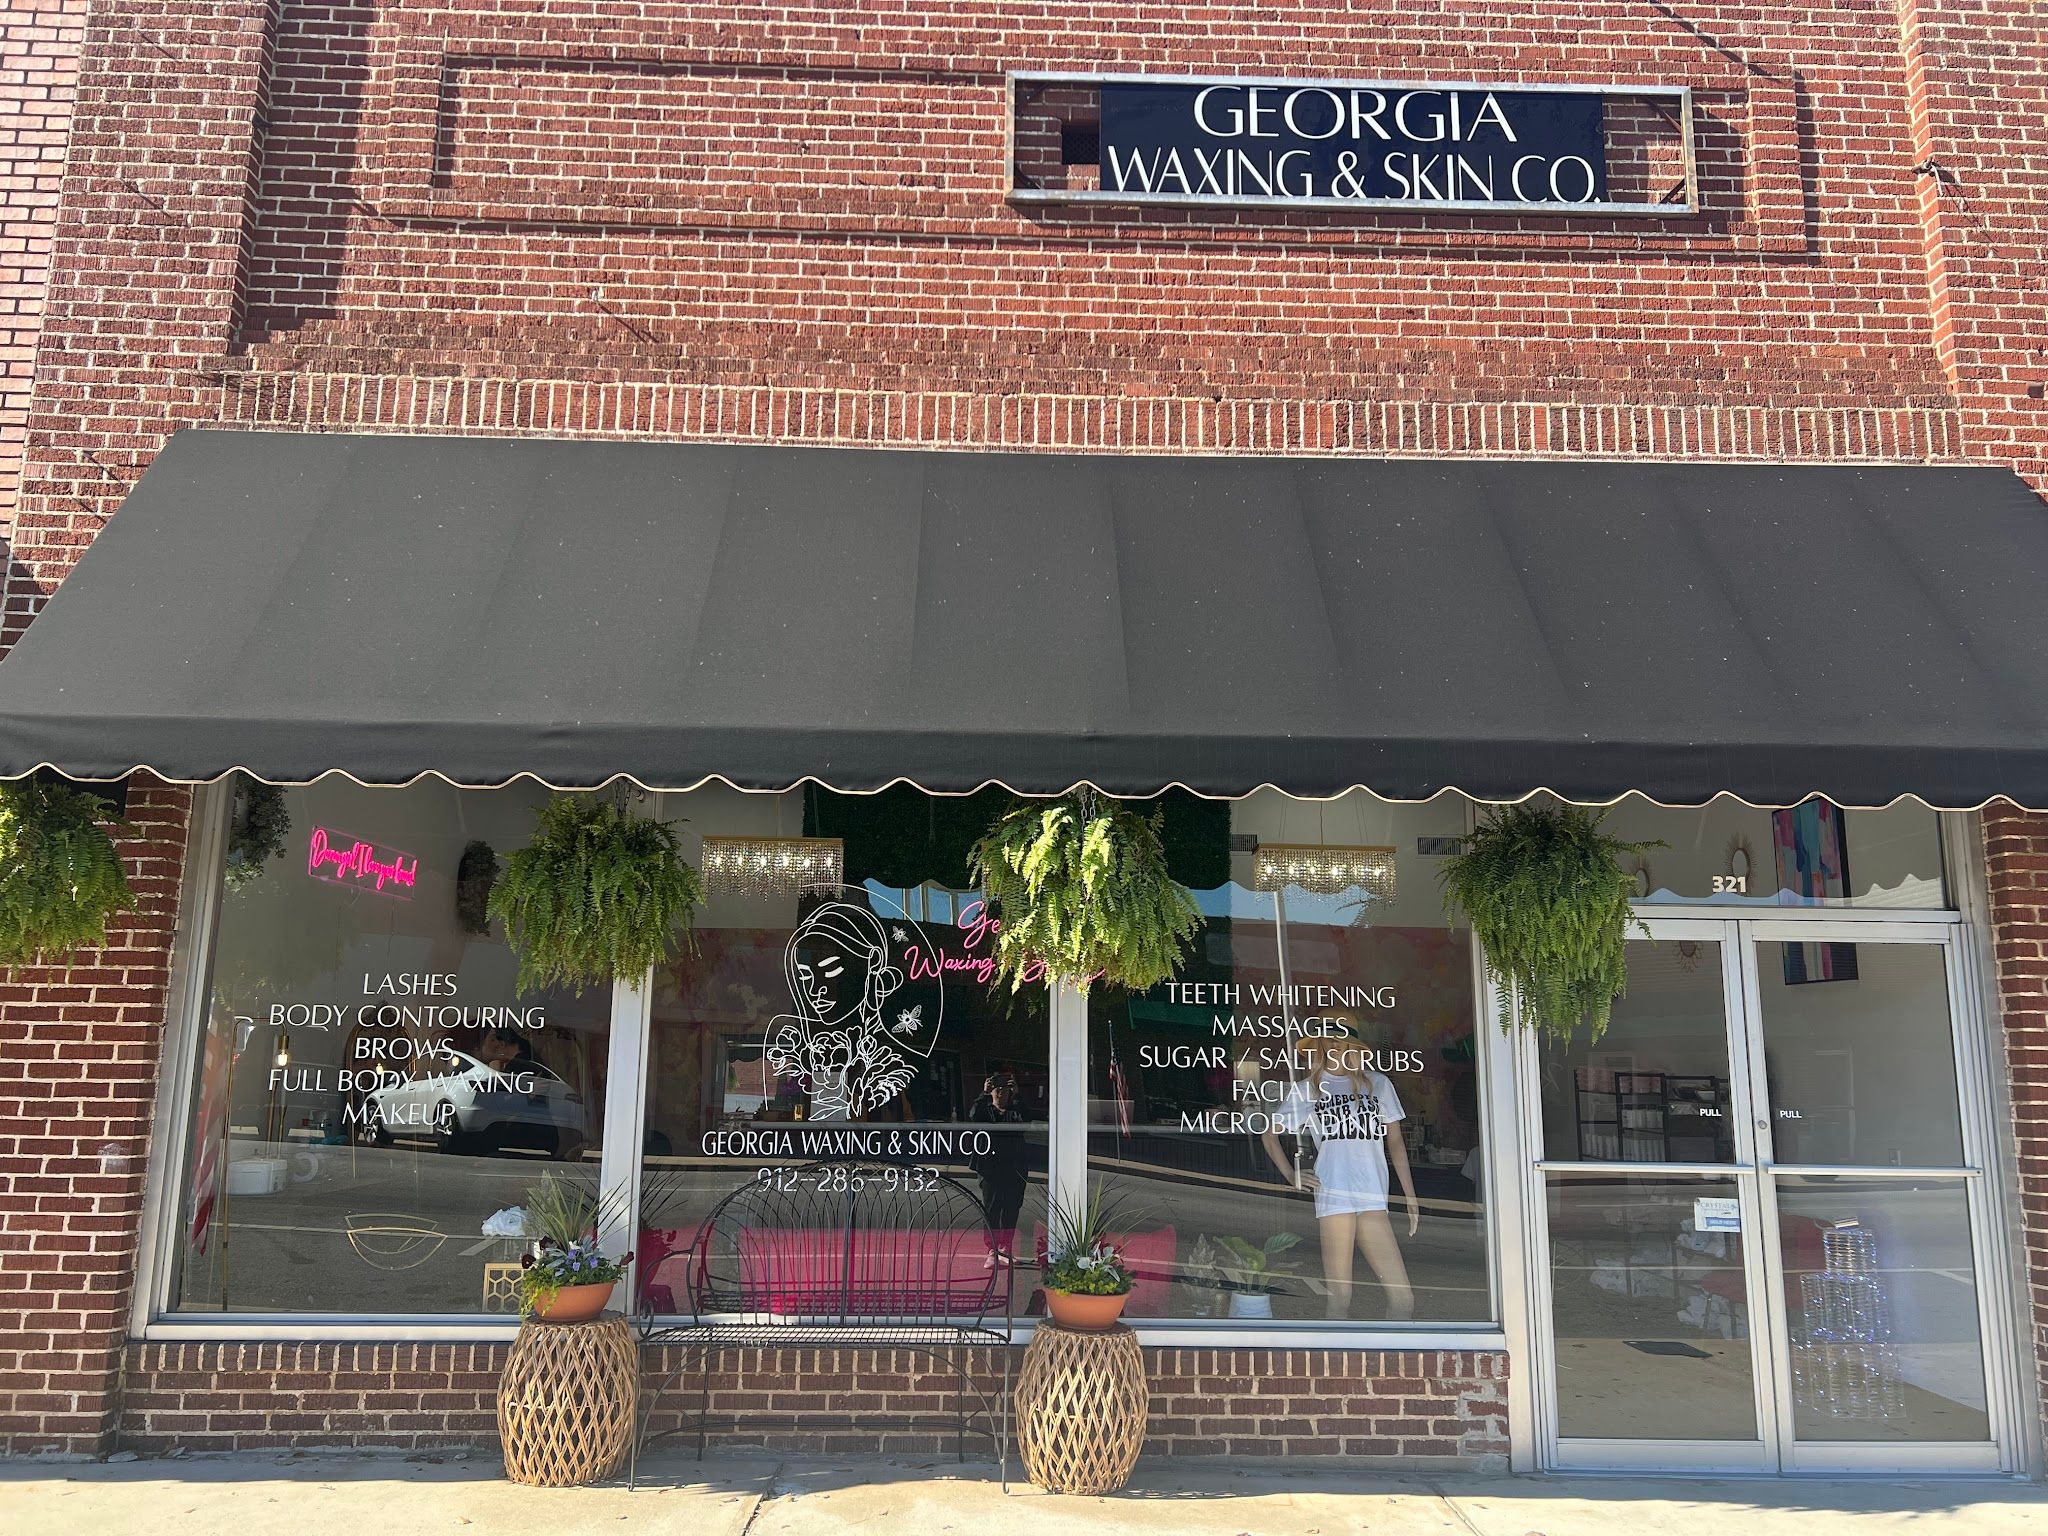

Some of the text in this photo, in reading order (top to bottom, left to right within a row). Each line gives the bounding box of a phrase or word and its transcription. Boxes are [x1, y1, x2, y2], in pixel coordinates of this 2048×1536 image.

[1193, 85, 1518, 143] GEORGIA
[1107, 144, 1601, 203] WAXING & SKIN CO.
[1712, 875, 1747, 893] 321
[904, 945, 995, 983] Waxing
[363, 973, 457, 996] LASHES
[1165, 982, 1396, 1008] TEETH WHITENING
[269, 1004, 545, 1029] BODY CONTOURING
[1212, 1015, 1349, 1039] MASSAGES
[354, 1037, 454, 1060] BROWS
[1139, 1045, 1424, 1073] SUGAR / SALT SCRUBS
[268, 1069, 534, 1094] FULL BODY WAXING
[1232, 1079, 1331, 1103] FACIALS
[341, 1103, 456, 1126] MAKEUP
[1180, 1110, 1388, 1137] MICROBLADING
[1700, 1108, 1722, 1117] PULL
[1780, 1110, 1802, 1118] PULL
[701, 1131, 996, 1156] GEORGIA WAXING & SKIN CO.
[757, 1167, 940, 1192] 912-286-9132
